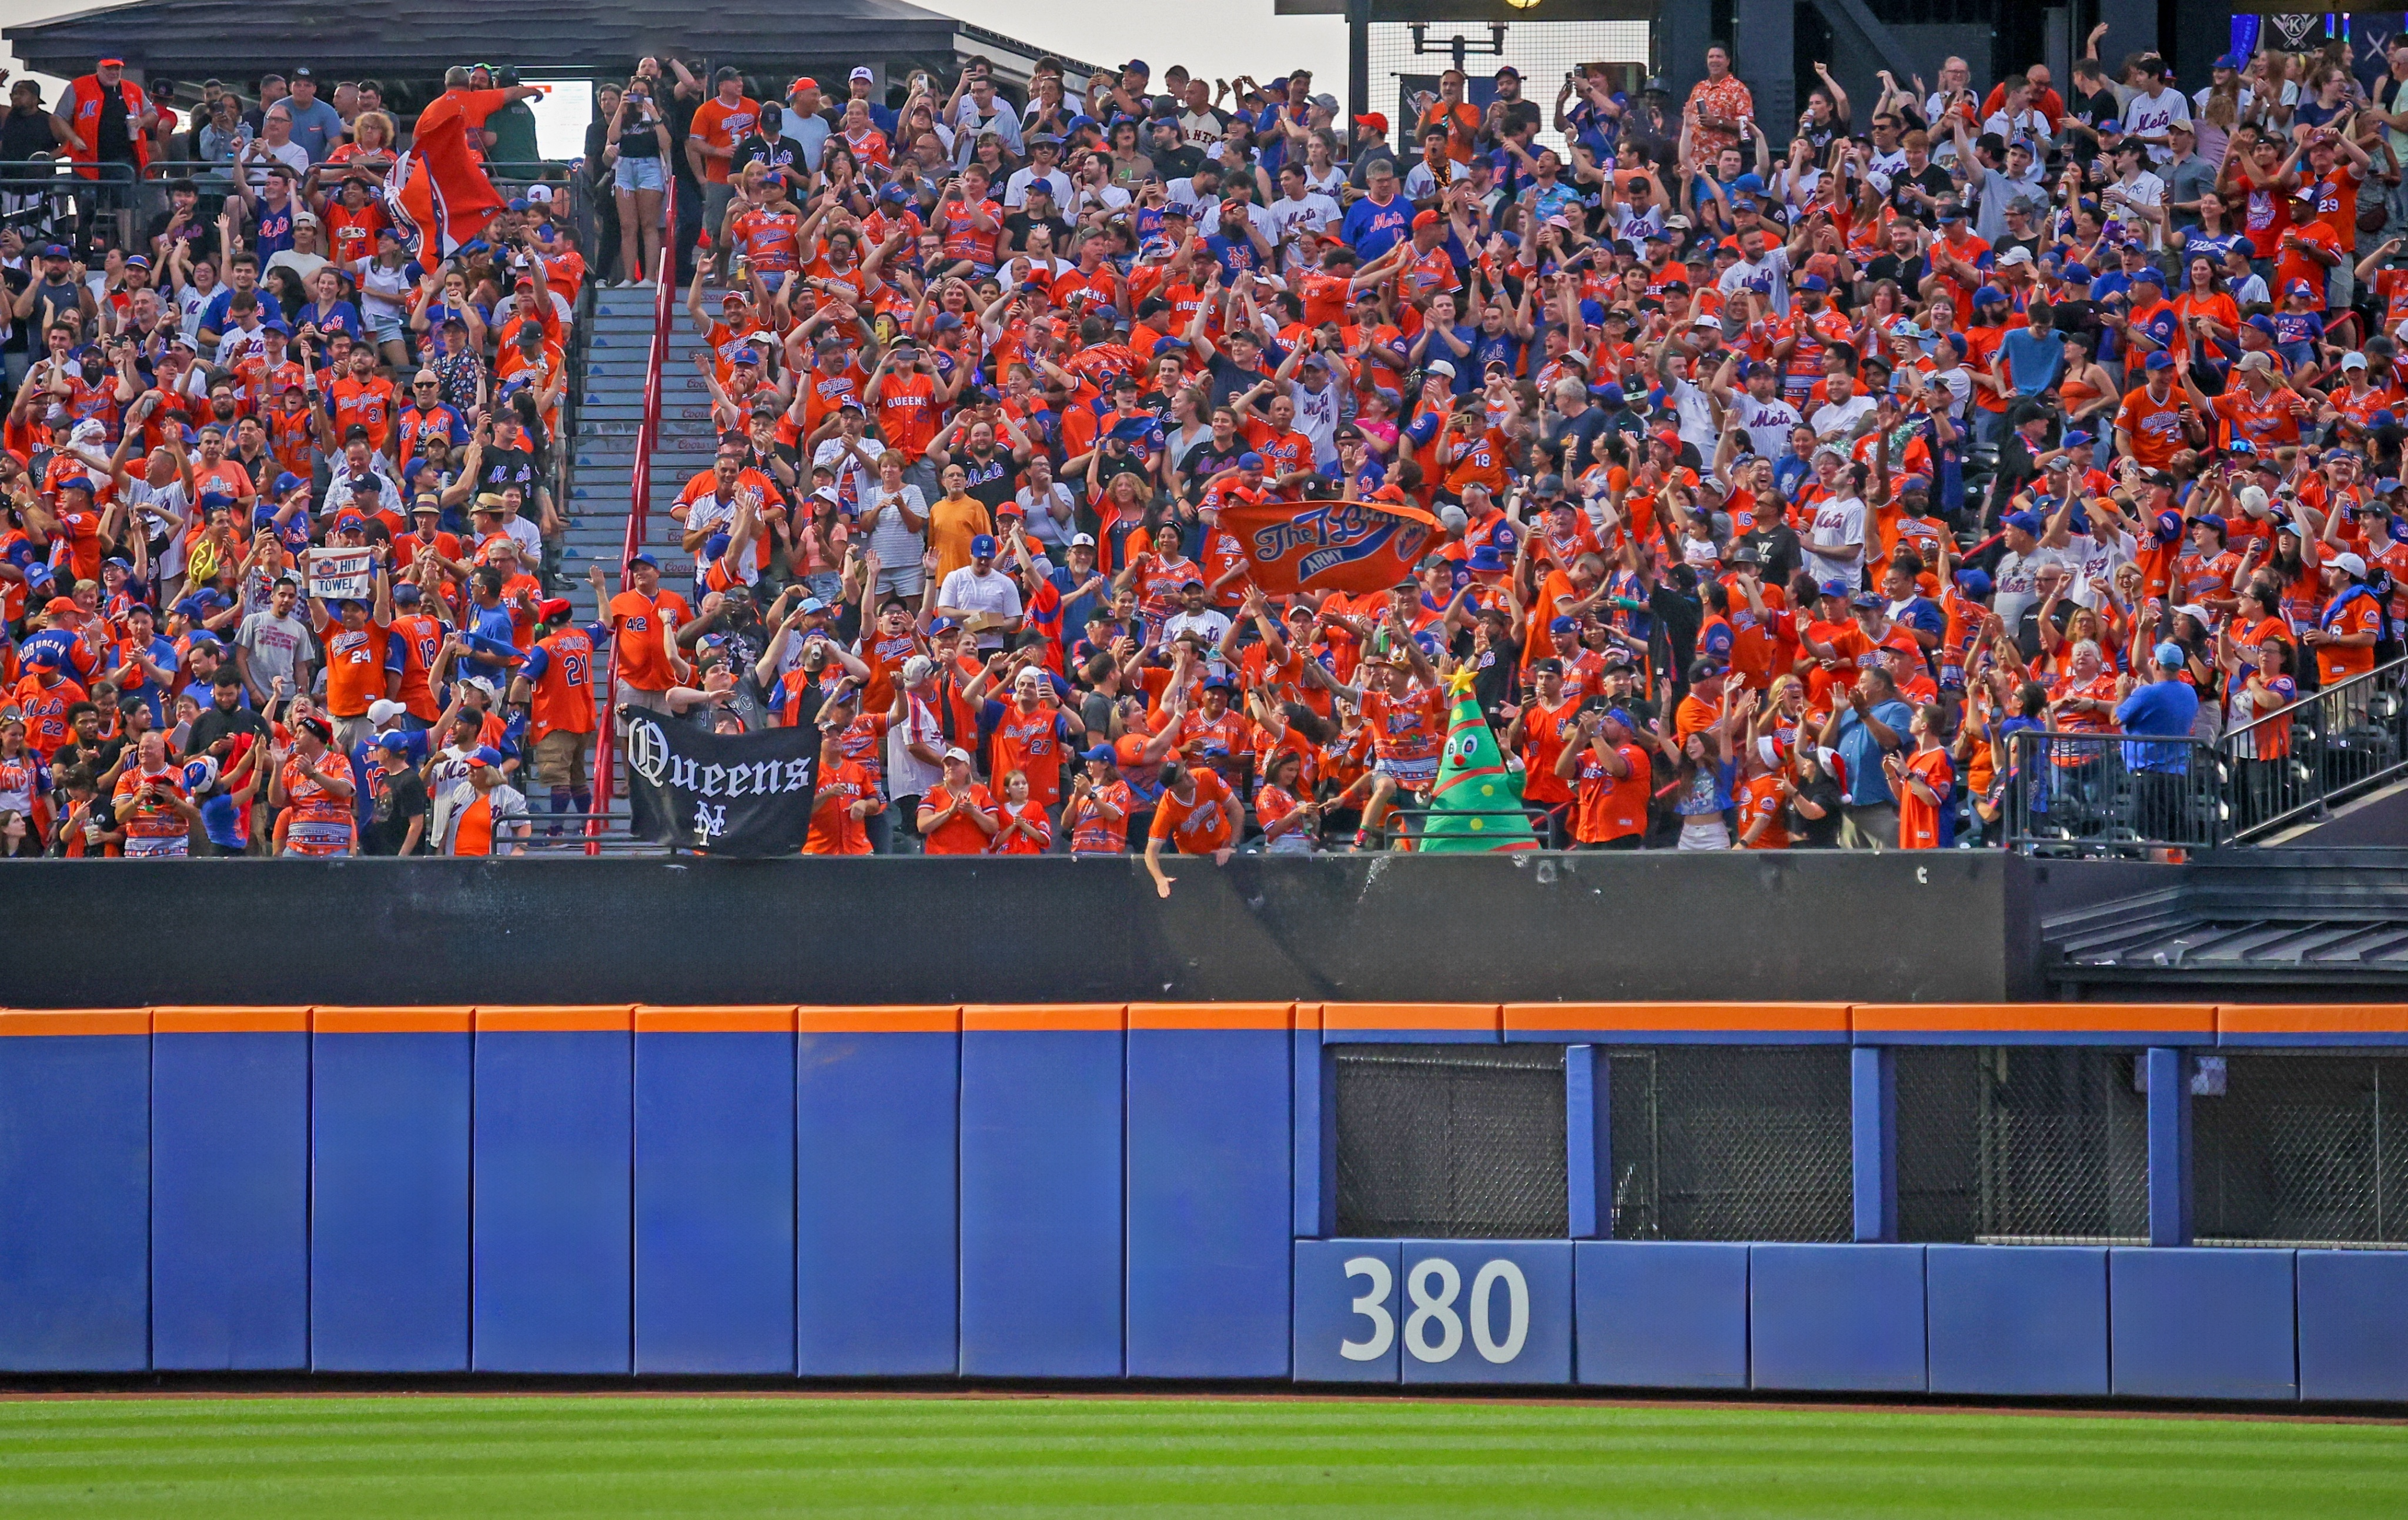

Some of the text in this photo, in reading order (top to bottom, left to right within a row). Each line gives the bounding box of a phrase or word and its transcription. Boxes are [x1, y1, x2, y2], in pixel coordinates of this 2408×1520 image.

[2133, 110, 2168, 132] Mets
[1869, 161, 1904, 175] Met
[2318, 199, 2339, 213] 29
[1142, 216, 1165, 231] Met
[1287, 207, 1316, 227] Mets
[1370, 212, 1404, 232] Mets
[1227, 245, 1252, 273] NY
[1742, 268, 1774, 286] Mts
[1176, 300, 1215, 315] QUEES
[321, 314, 344, 333] ets
[505, 332, 520, 350] QUE
[1277, 337, 1296, 350] ENS
[340, 392, 383, 411] New York
[887, 397, 927, 408] QUEENS
[369, 408, 382, 422] 31
[682, 408, 710, 418] Coors
[1320, 411, 1330, 425] 16
[1750, 411, 1790, 427] Mets
[678, 438, 705, 448] Coors
[1257, 440, 1297, 459] Mets
[1475, 453, 1490, 467] 18
[489, 464, 531, 483] Met
[965, 463, 1004, 488] Mets
[1357, 476, 1374, 494] ts
[1738, 511, 1753, 526] 16
[1817, 511, 1844, 528] Mets
[2142, 535, 2159, 551] 30
[340, 556, 356, 572] HIT
[665, 562, 691, 572] Coors
[1306, 549, 1343, 573] ARMY
[319, 578, 354, 592] TOWEL
[1999, 577, 2028, 593] Mets
[626, 617, 647, 632] 42
[351, 649, 372, 664] 24
[420, 638, 436, 669] 18
[565, 654, 590, 687] 21
[24, 699, 63, 718] Mets
[43, 720, 64, 735] 22
[1004, 723, 1048, 742] New York
[1031, 740, 1051, 755] 27
[628, 717, 811, 798] Queens
[439, 761, 467, 782] Me
[315, 799, 333, 812] 24
[694, 800, 725, 846] NY
[1090, 828, 1107, 842] 24
[1340, 1257, 1529, 1364] 380
